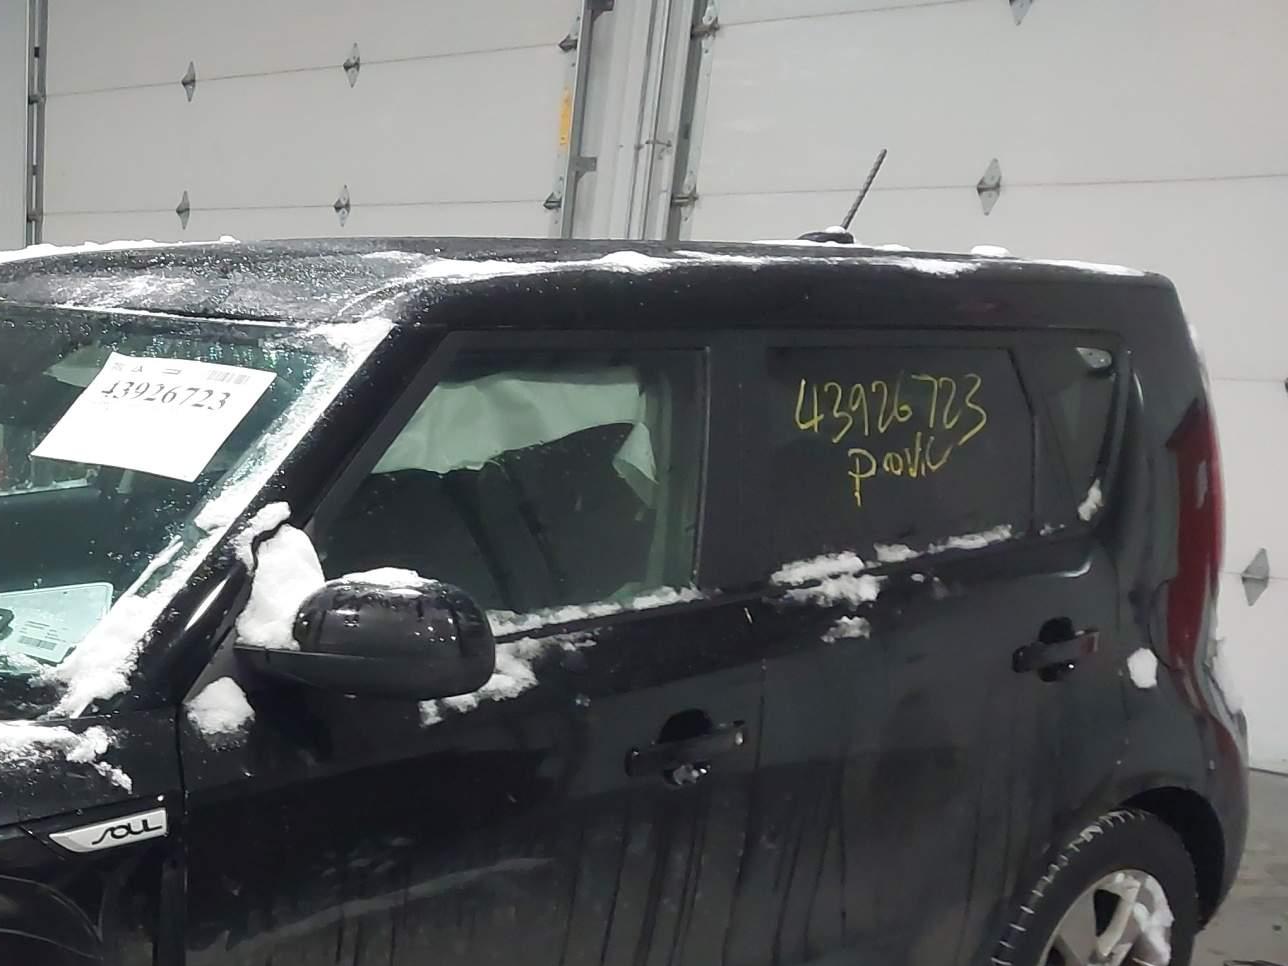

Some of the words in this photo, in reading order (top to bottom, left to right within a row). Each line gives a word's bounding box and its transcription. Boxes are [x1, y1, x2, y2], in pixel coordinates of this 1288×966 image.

[100, 380, 232, 411] 43926723
[793, 371, 988, 446] 43926723
[91, 818, 163, 846] SOUL
